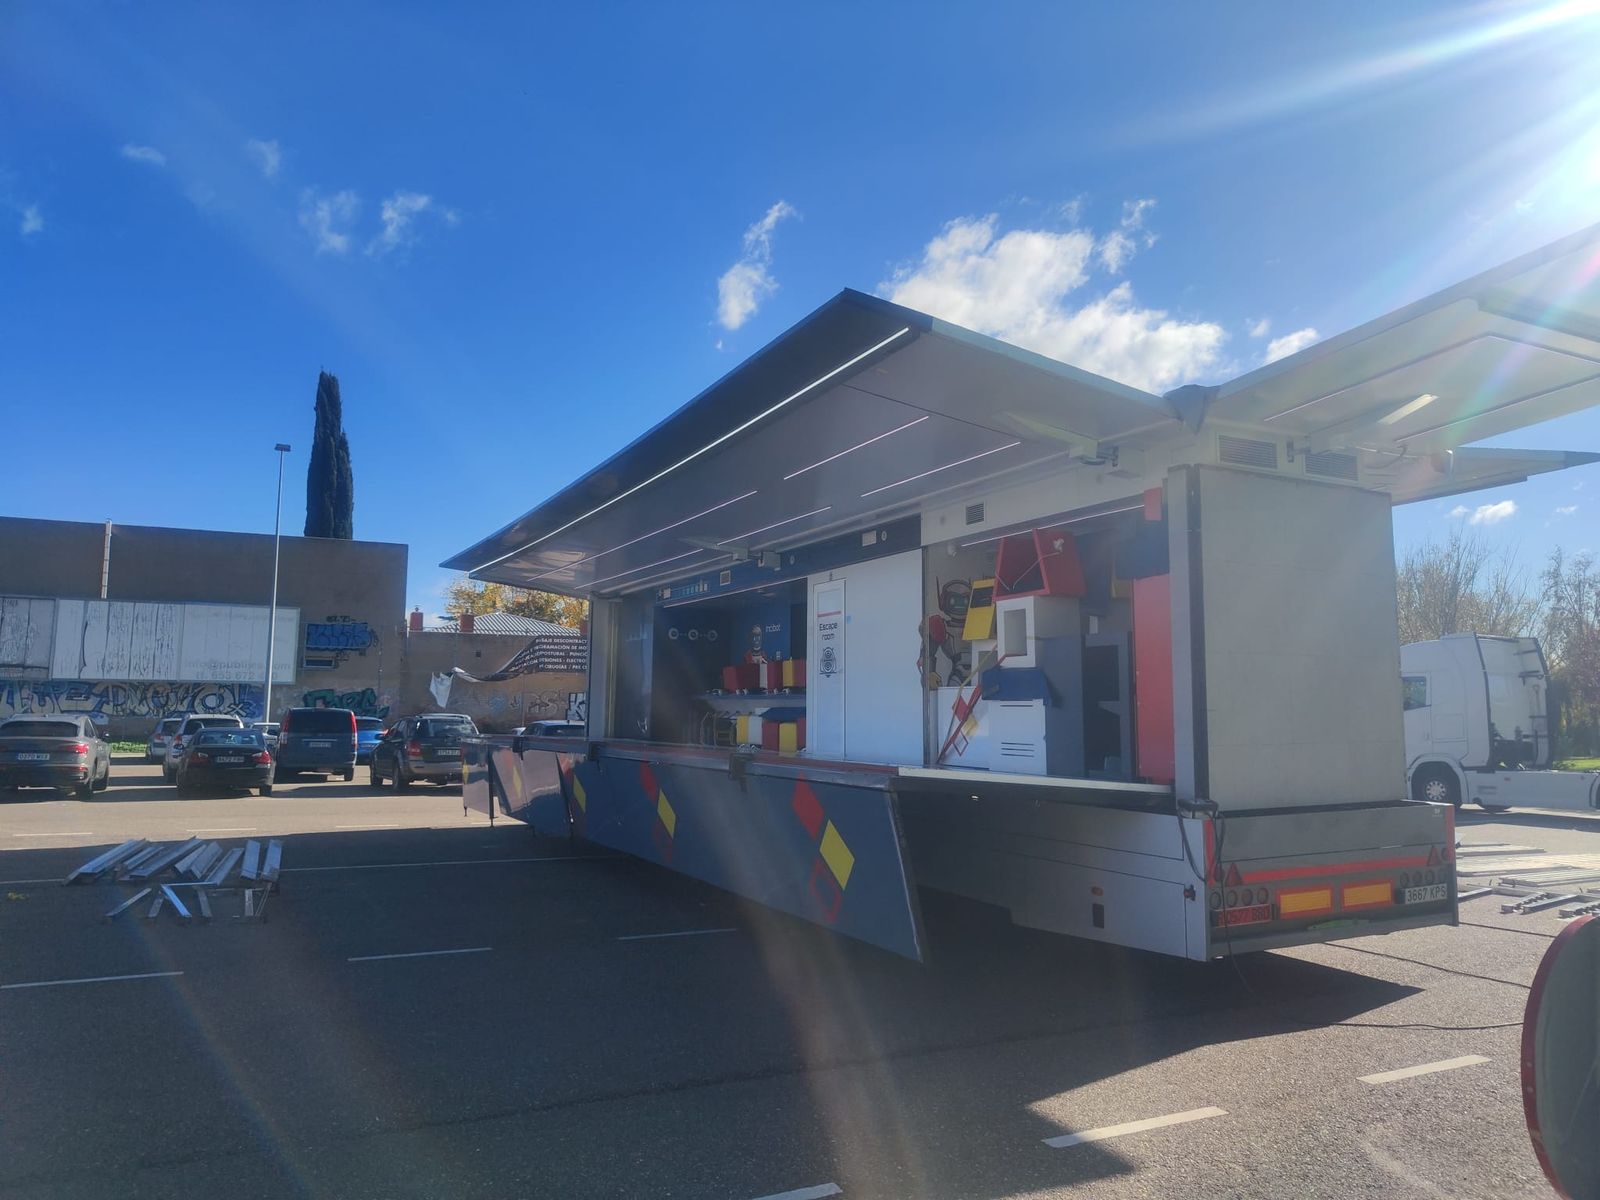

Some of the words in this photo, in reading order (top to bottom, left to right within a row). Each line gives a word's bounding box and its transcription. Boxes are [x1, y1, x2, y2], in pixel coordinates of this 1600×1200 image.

[819, 622, 838, 632] Escape
[821, 633, 835, 641] room
[1430, 885, 1446, 899] KPS
